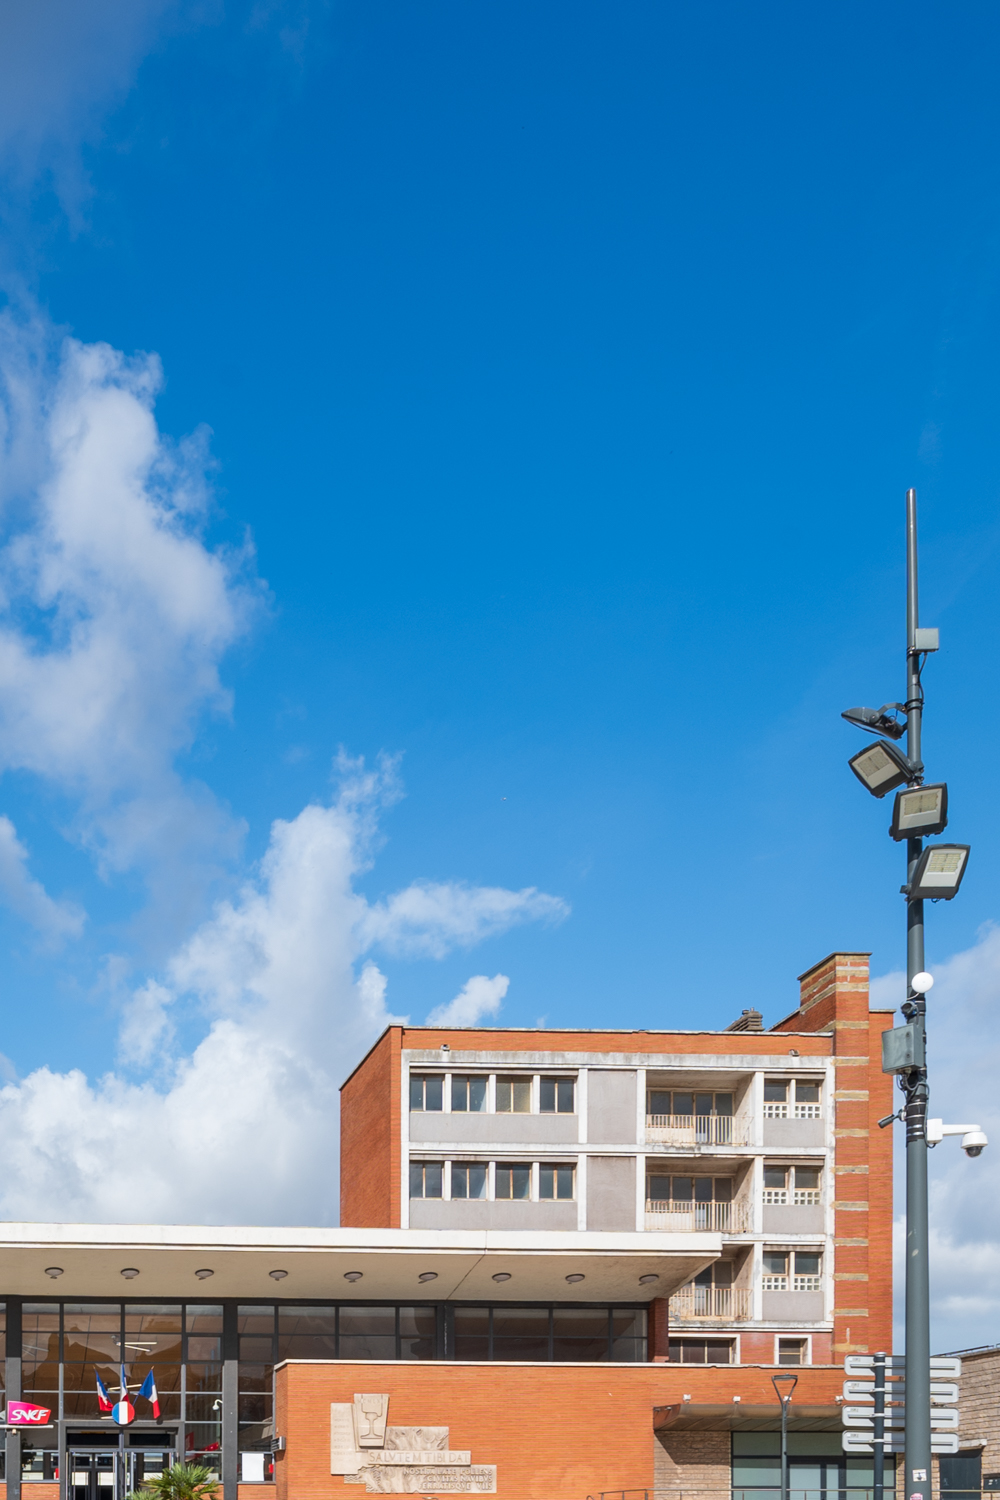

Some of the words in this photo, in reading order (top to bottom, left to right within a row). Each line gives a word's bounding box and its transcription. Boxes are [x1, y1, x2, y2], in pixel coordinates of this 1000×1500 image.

[10, 1408, 50, 1421] SNCF
[369, 1451, 422, 1463] SALVTEM
[424, 1451, 446, 1463] TIBI
[448, 1451, 470, 1463] DAT
